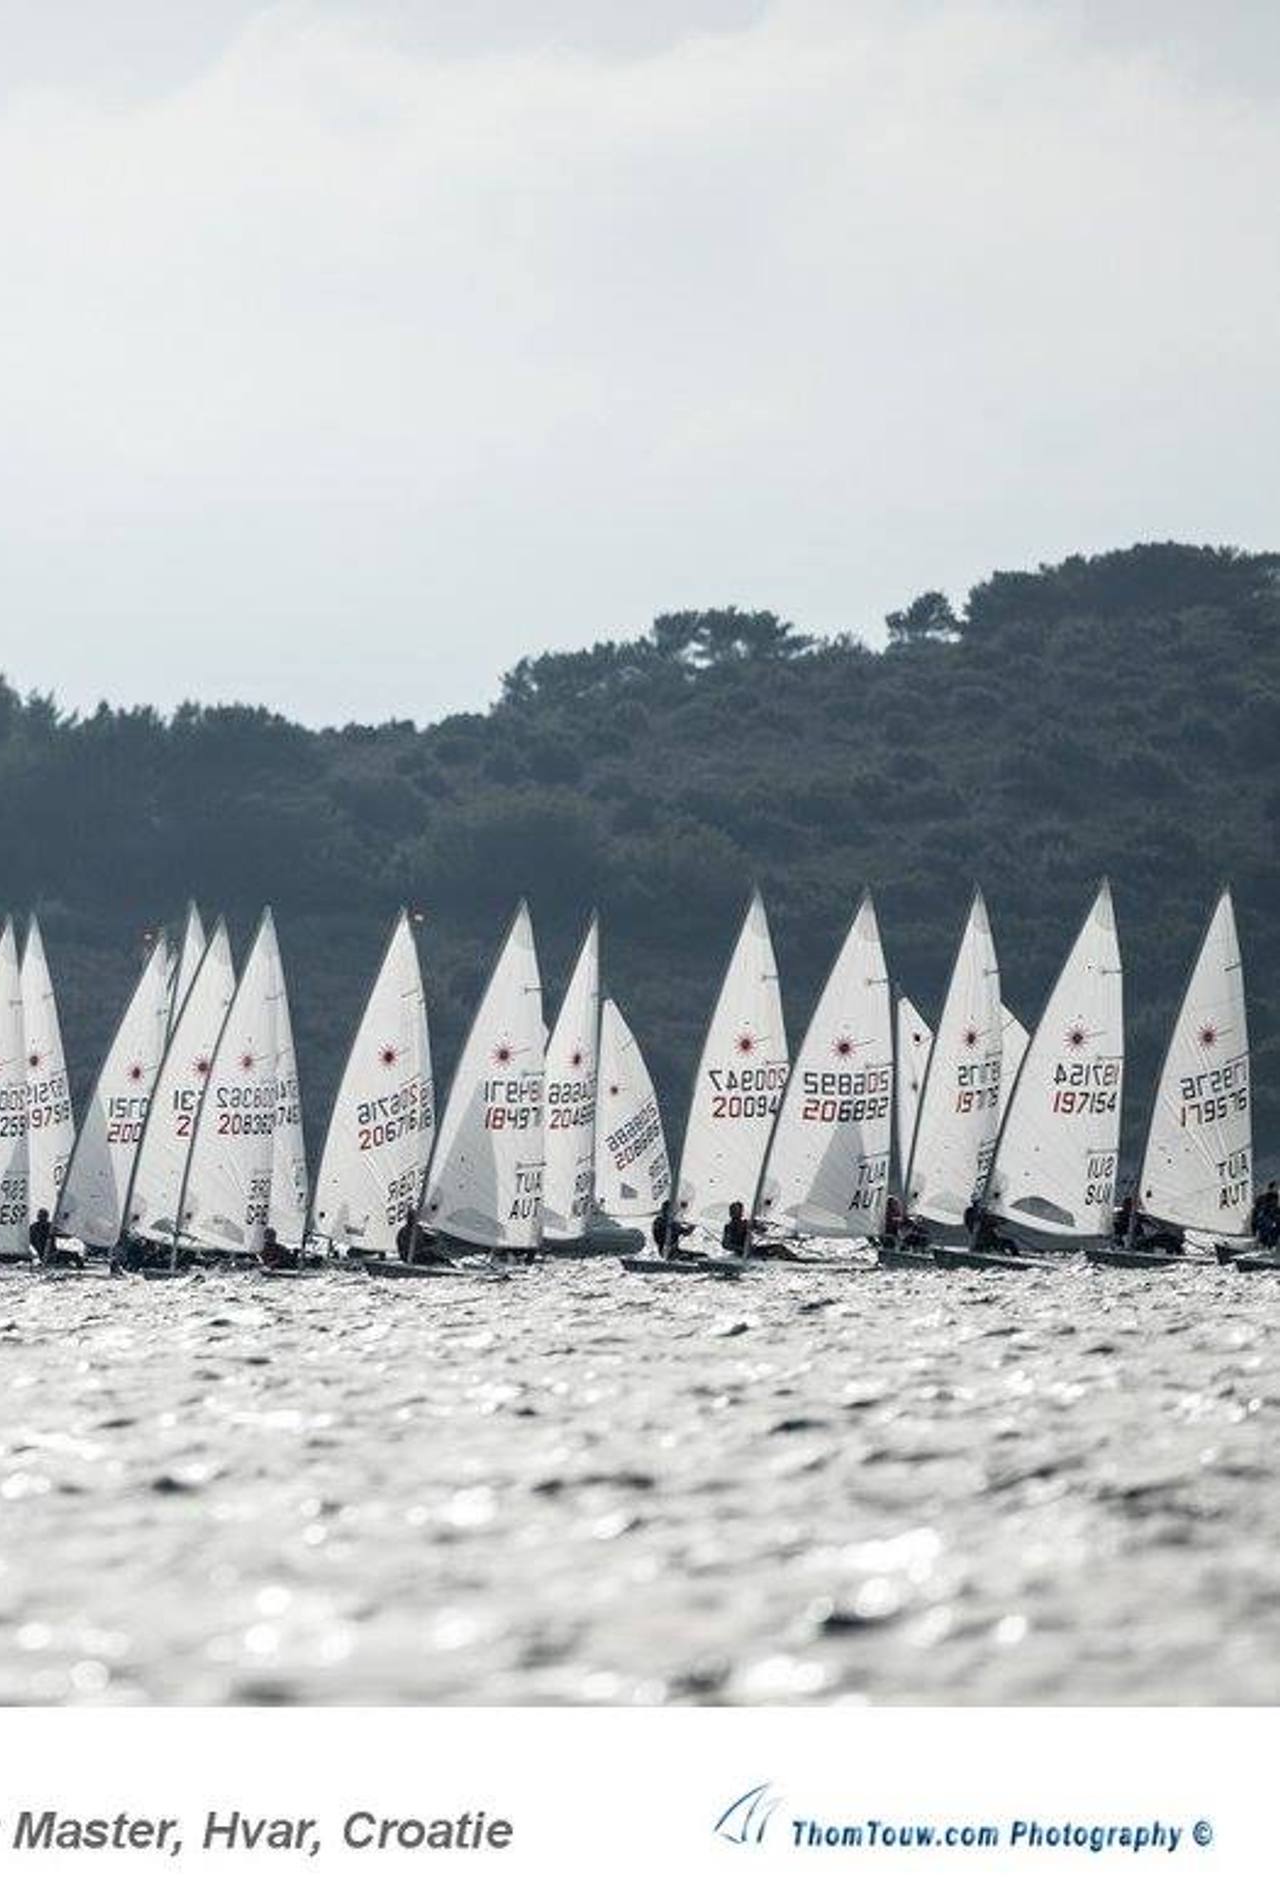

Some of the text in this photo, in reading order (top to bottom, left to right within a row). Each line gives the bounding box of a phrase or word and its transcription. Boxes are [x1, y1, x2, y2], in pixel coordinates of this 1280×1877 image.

[802, 1096, 889, 1123] 206892
[1052, 1091, 1118, 1114] 197154
[848, 1186, 885, 1211] AUT
[1084, 1184, 1113, 1207] SUI
[1219, 1181, 1249, 1209] AUT
[508, 1198, 542, 1220] AUT
